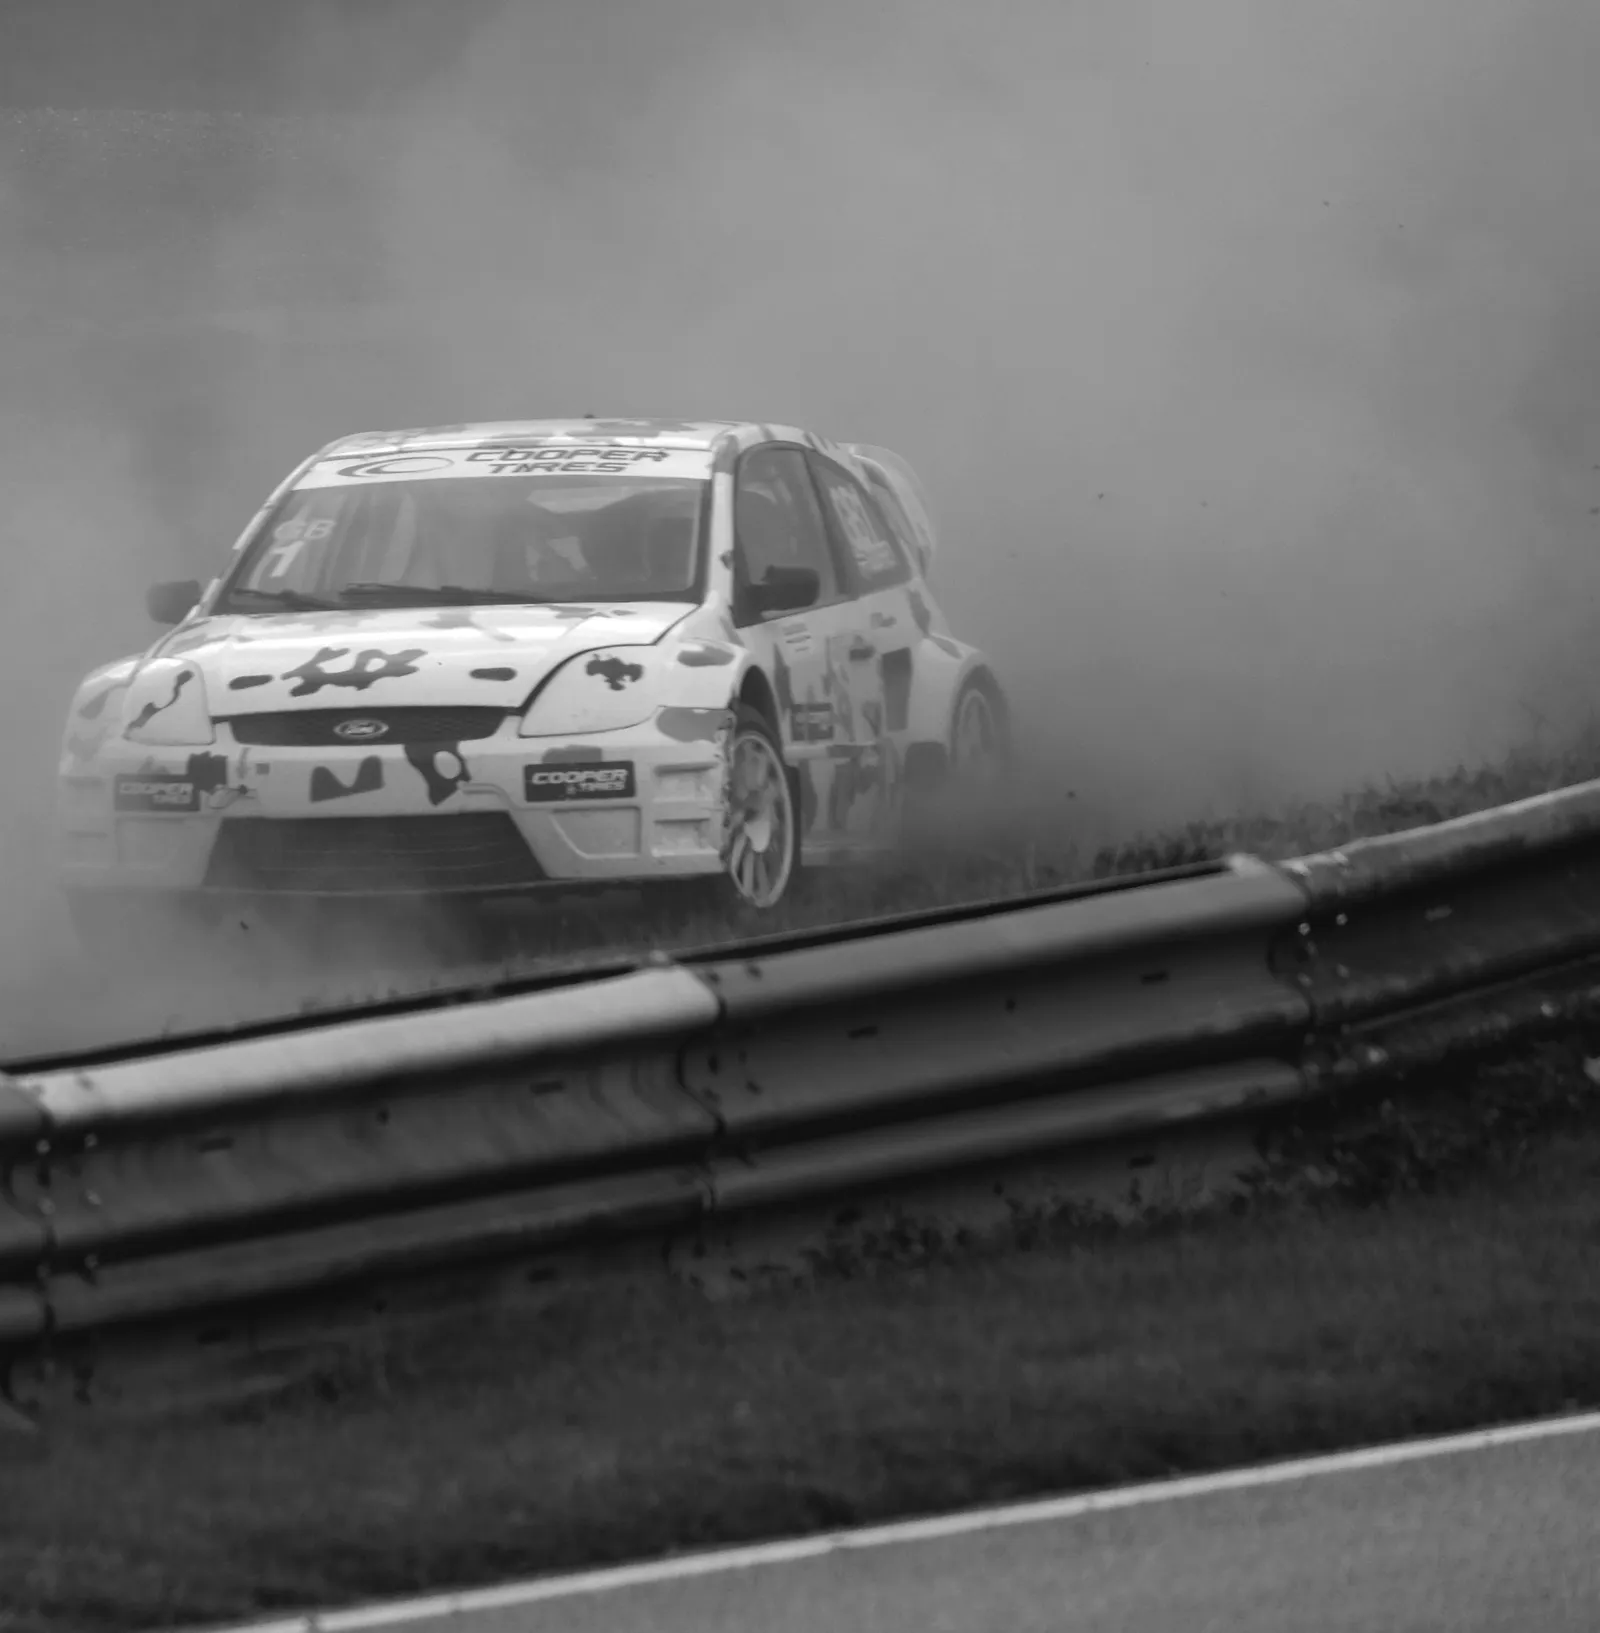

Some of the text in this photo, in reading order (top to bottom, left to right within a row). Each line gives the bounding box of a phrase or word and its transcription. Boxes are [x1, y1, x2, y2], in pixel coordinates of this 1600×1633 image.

[465, 448, 670, 463] COOPER
[488, 461, 630, 475] TIRES
[269, 541, 304, 577] 1
[532, 769, 628, 785] COOPER
